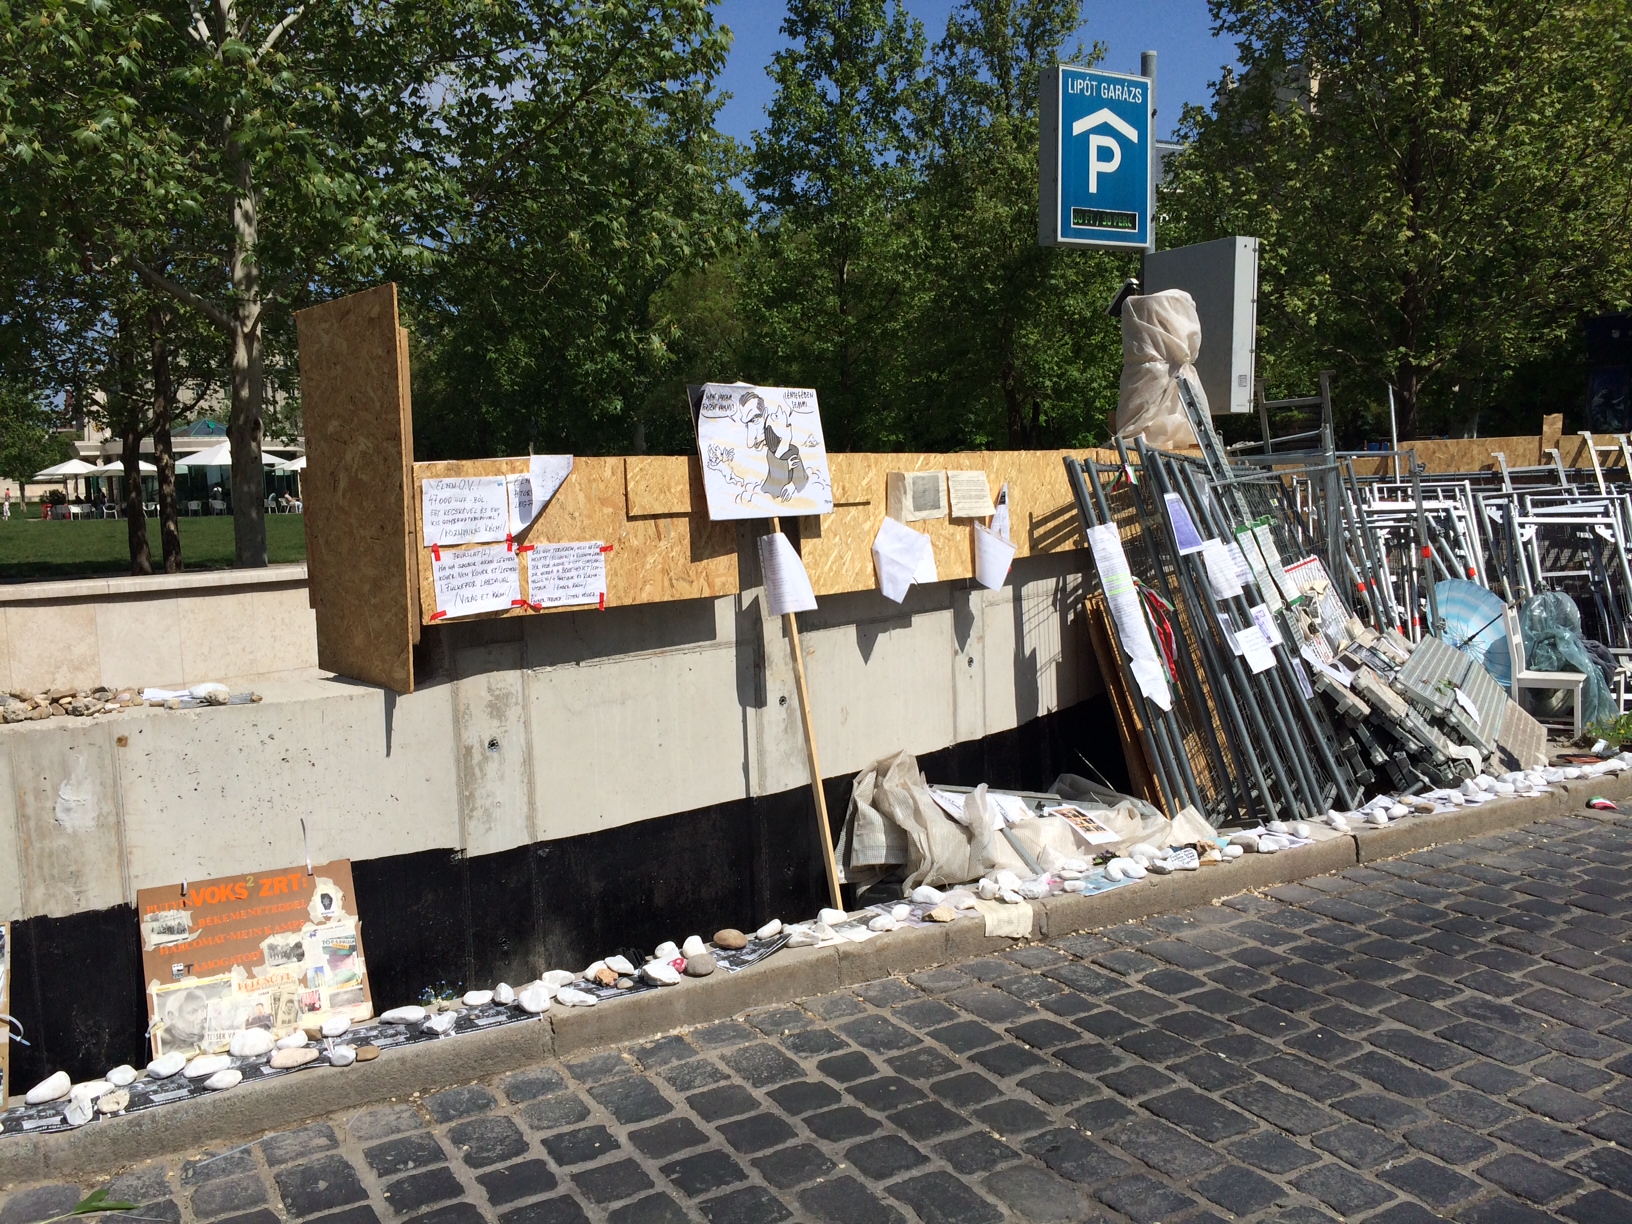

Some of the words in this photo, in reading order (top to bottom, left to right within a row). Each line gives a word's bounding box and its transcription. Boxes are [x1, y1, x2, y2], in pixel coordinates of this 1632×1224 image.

[1068, 77, 1097, 96] LIPÓT
[1101, 83, 1142, 103] GARÁZS
[1089, 134, 1121, 194] P
[1085, 213, 1093, 224] FT
[1102, 214, 1111, 225] 30
[1113, 215, 1132, 227] PERC
[259, 873, 307, 897] ZRT:
